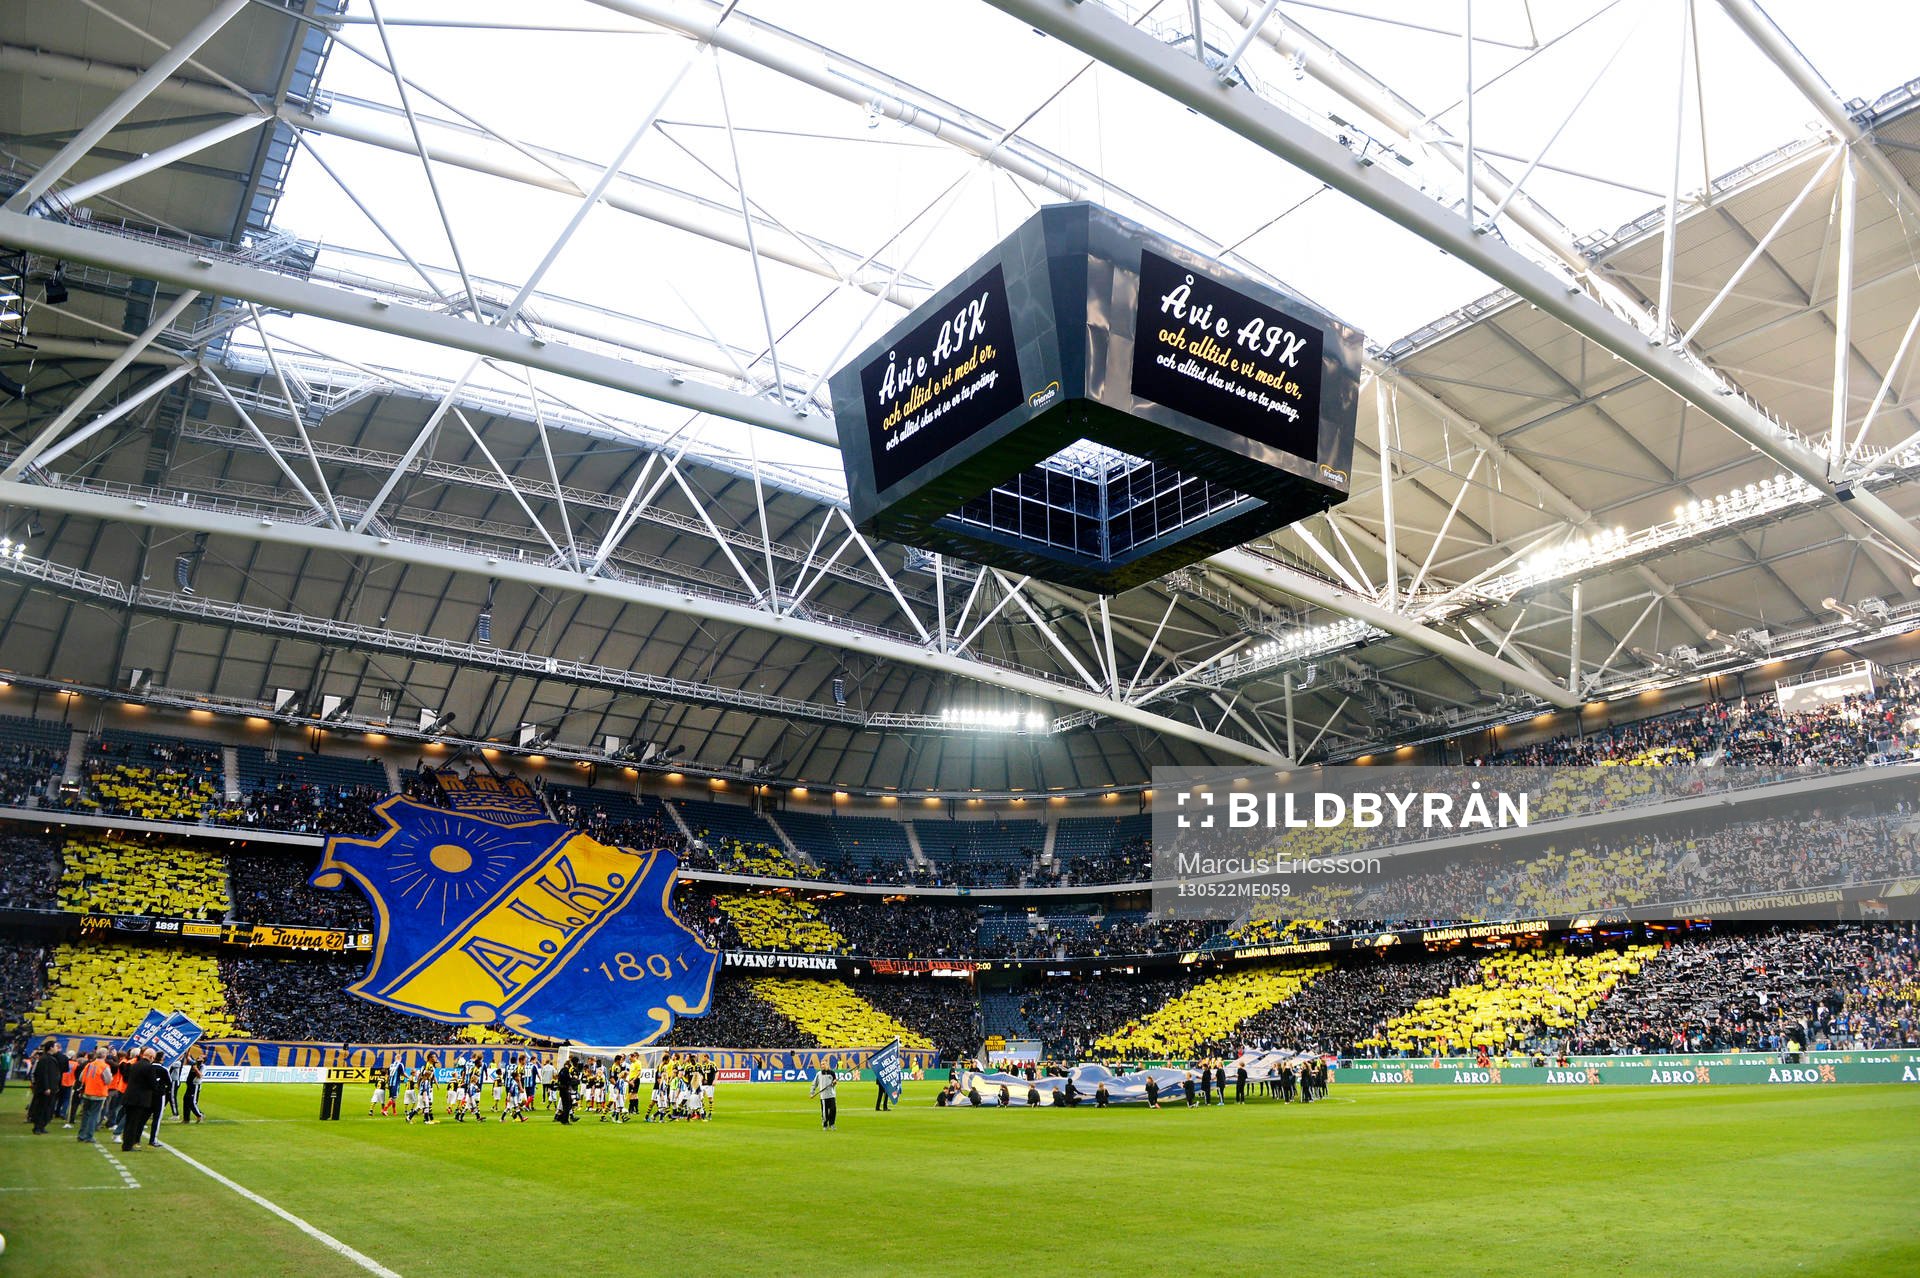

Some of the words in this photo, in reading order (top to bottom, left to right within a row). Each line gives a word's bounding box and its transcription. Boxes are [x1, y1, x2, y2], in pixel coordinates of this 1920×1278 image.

[1161, 274, 1194, 318] Å
[1189, 304, 1213, 330] vi
[1216, 317, 1230, 338] e
[1237, 317, 1307, 368] AIK
[878, 351, 896, 405] Å
[898, 357, 914, 393] vi
[916, 356, 928, 378] e
[932, 291, 989, 366] AIK
[1158, 327, 1187, 350] och
[1189, 335, 1232, 367] alltid
[1230, 359, 1240, 371] e
[1241, 361, 1255, 378] vi
[1255, 371, 1286, 391] med
[1285, 381, 1303, 400] er,
[883, 400, 902, 431] och
[903, 377, 933, 414] alltid
[933, 383, 941, 396] e
[941, 367, 954, 391] vi
[954, 344, 978, 382] med
[1157, 353, 1176, 370] och
[1177, 360, 1207, 382] alltid
[1206, 371, 1225, 388] ska
[1225, 381, 1236, 393] vi
[1235, 386, 1247, 398] se
[1247, 390, 1258, 402] er
[1258, 393, 1269, 407] ta
[1267, 400, 1301, 422] poäng.
[885, 430, 900, 451] och
[900, 414, 920, 442] alltid
[920, 408, 933, 428] ska
[933, 403, 942, 420] vi
[942, 398, 951, 413] se
[1672, 899, 1735, 919] ALLMÄNNA
[1735, 890, 1844, 912] IDROTTSKLUBBEN
[155, 921, 179, 931] 1891
[1423, 926, 1469, 942] ALLMÄNNA
[1469, 920, 1549, 939] IDROTTSKLUBBEN
[272, 929, 323, 948] Turina
[1234, 948, 1269, 959] ALLMÄNNA
[1269, 942, 1330, 957] IDROTTSKLUBBEN
[725, 953, 768, 968] IVAN
[777, 954, 837, 970] TURINA
[328, 1069, 366, 1079] ITEX
[1371, 1070, 1403, 1083] ÅBRO
[1454, 1070, 1490, 1084] ÅBRO
[1546, 1069, 1587, 1084] ÅBRO
[1650, 1068, 1695, 1084] ÅBRO
[1768, 1066, 1819, 1083] ÅBRO
